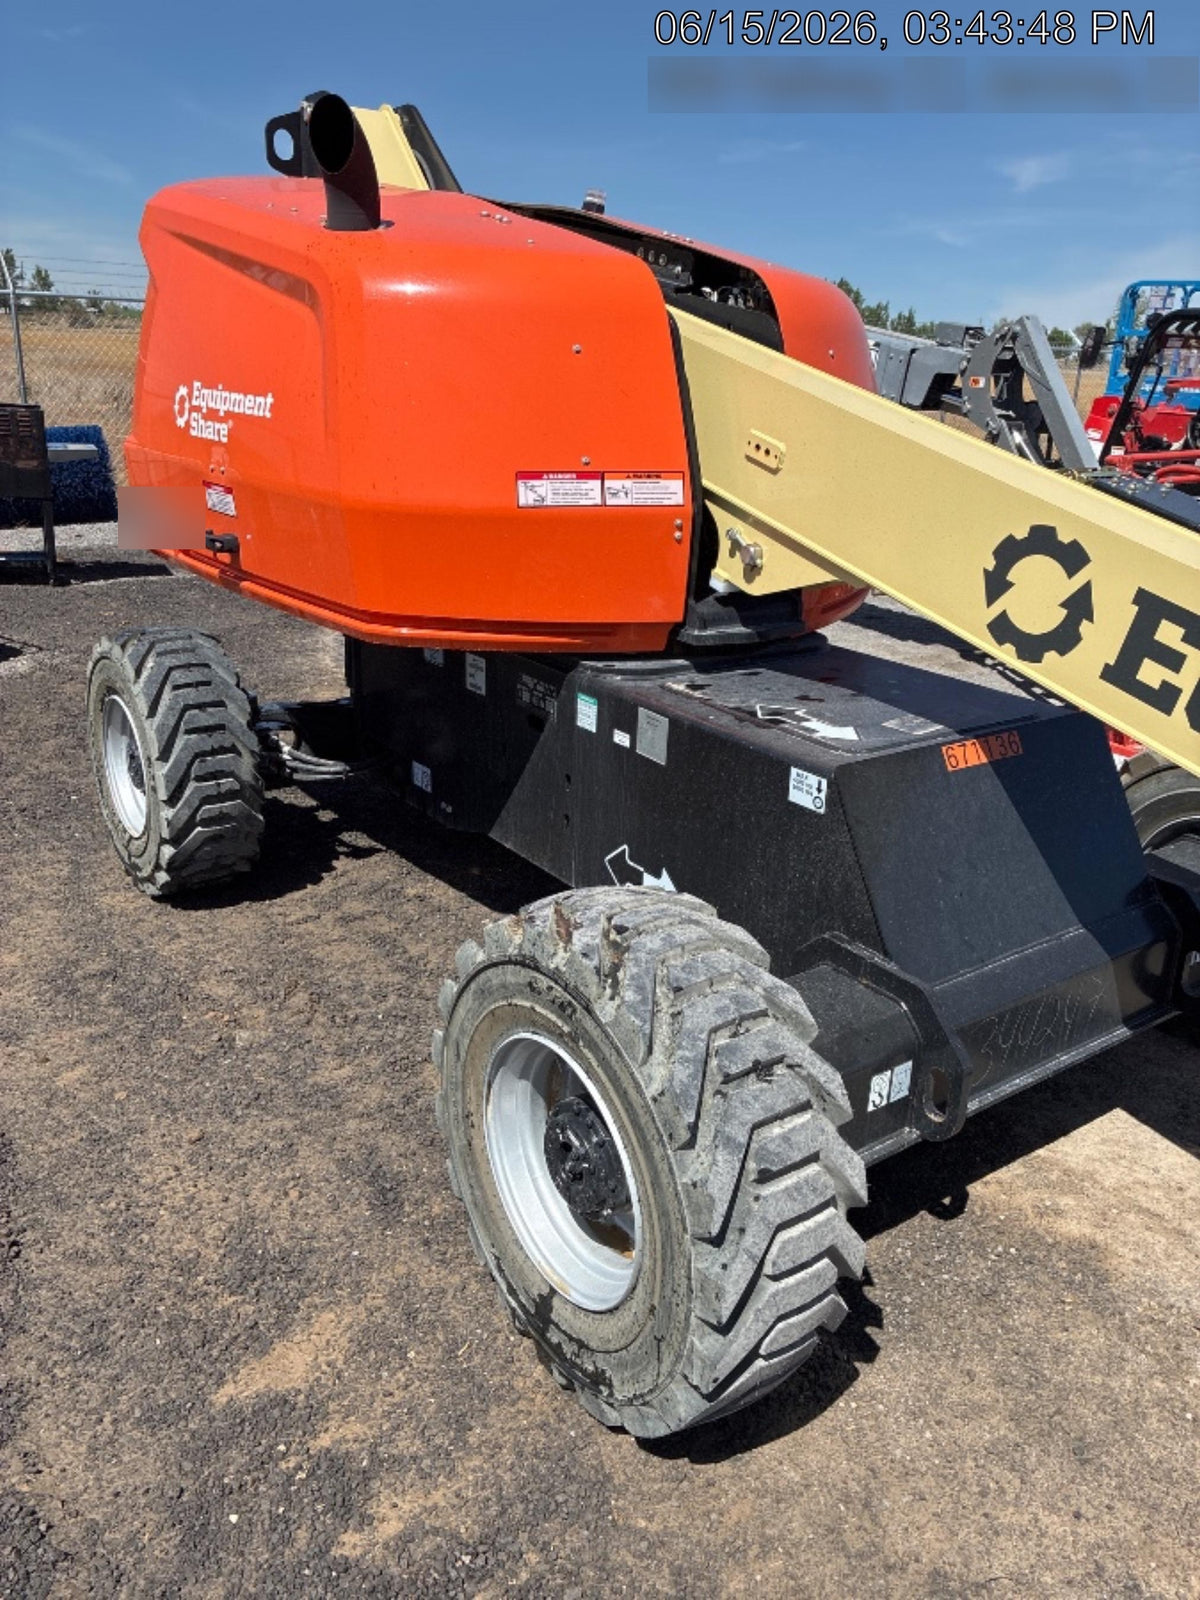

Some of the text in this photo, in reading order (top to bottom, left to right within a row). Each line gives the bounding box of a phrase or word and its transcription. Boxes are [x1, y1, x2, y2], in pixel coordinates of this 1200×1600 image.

[191, 380, 274, 418] Equipment
[1099, 586, 1200, 733] E
[945, 731, 1020, 769] 671136
